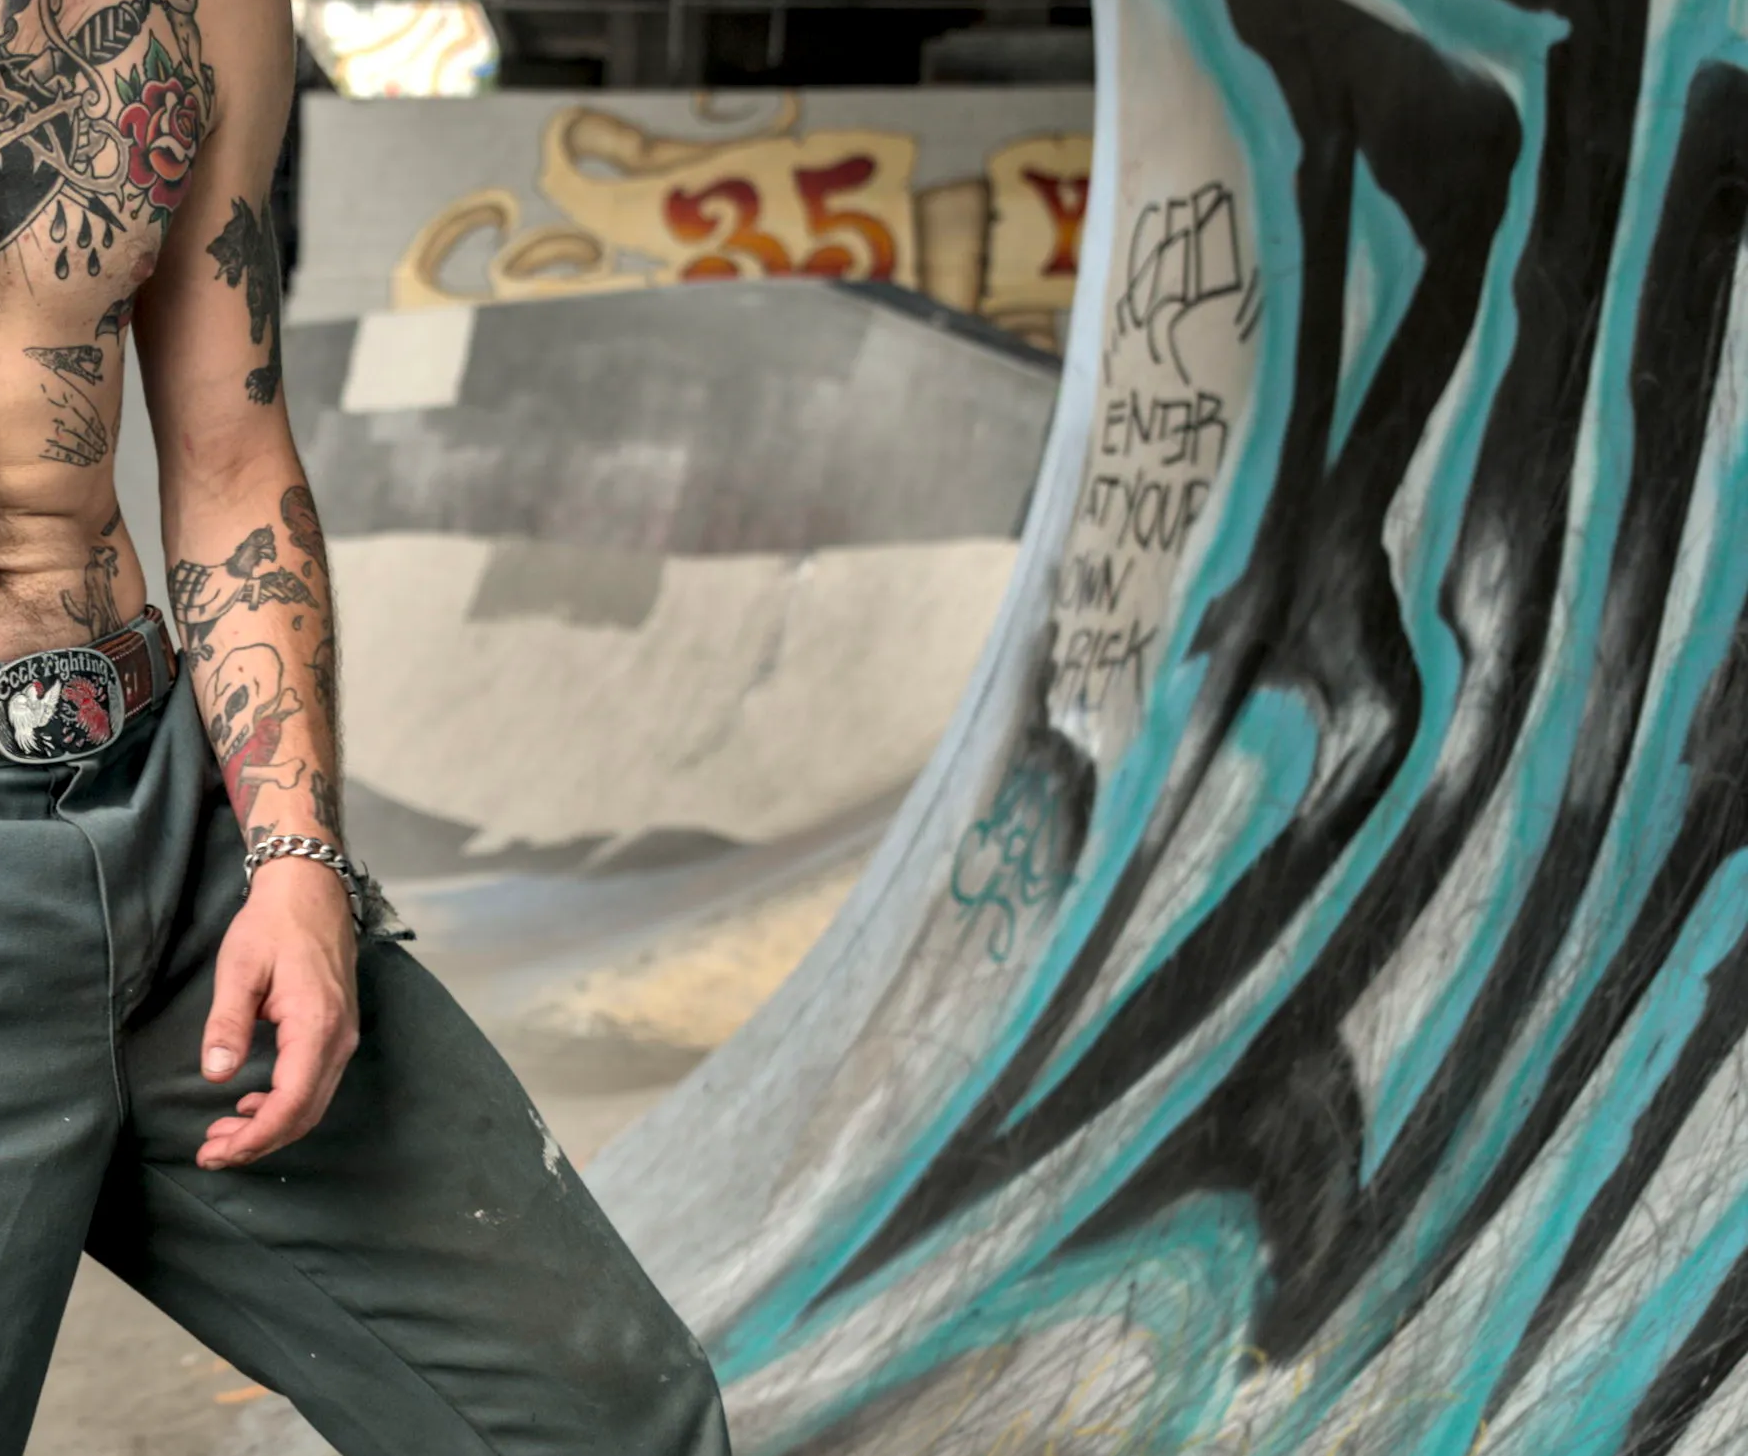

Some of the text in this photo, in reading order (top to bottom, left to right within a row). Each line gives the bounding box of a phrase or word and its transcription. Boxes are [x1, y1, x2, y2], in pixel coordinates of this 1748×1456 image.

[663, 156, 898, 282] 35
[1101, 389, 1228, 469] ENTER
[41, 652, 108, 685] Fighting
